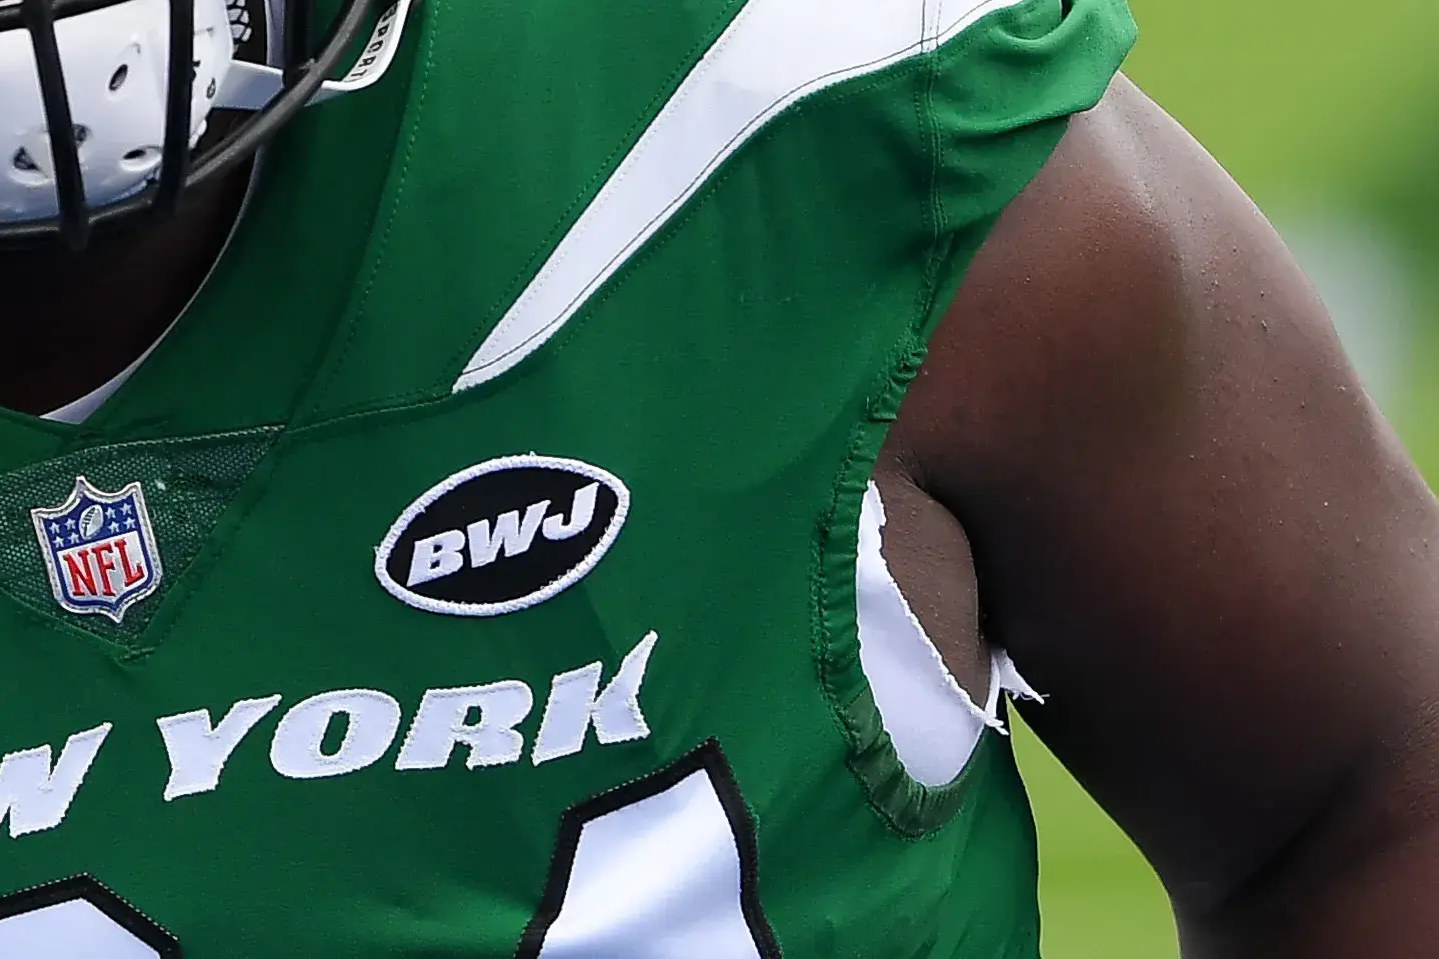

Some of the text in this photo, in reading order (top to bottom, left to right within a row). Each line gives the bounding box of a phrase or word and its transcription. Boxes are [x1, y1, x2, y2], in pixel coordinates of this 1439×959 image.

[61, 537, 145, 598] NFL
[406, 481, 600, 587] BWJ
[156, 630, 659, 802] YORK
